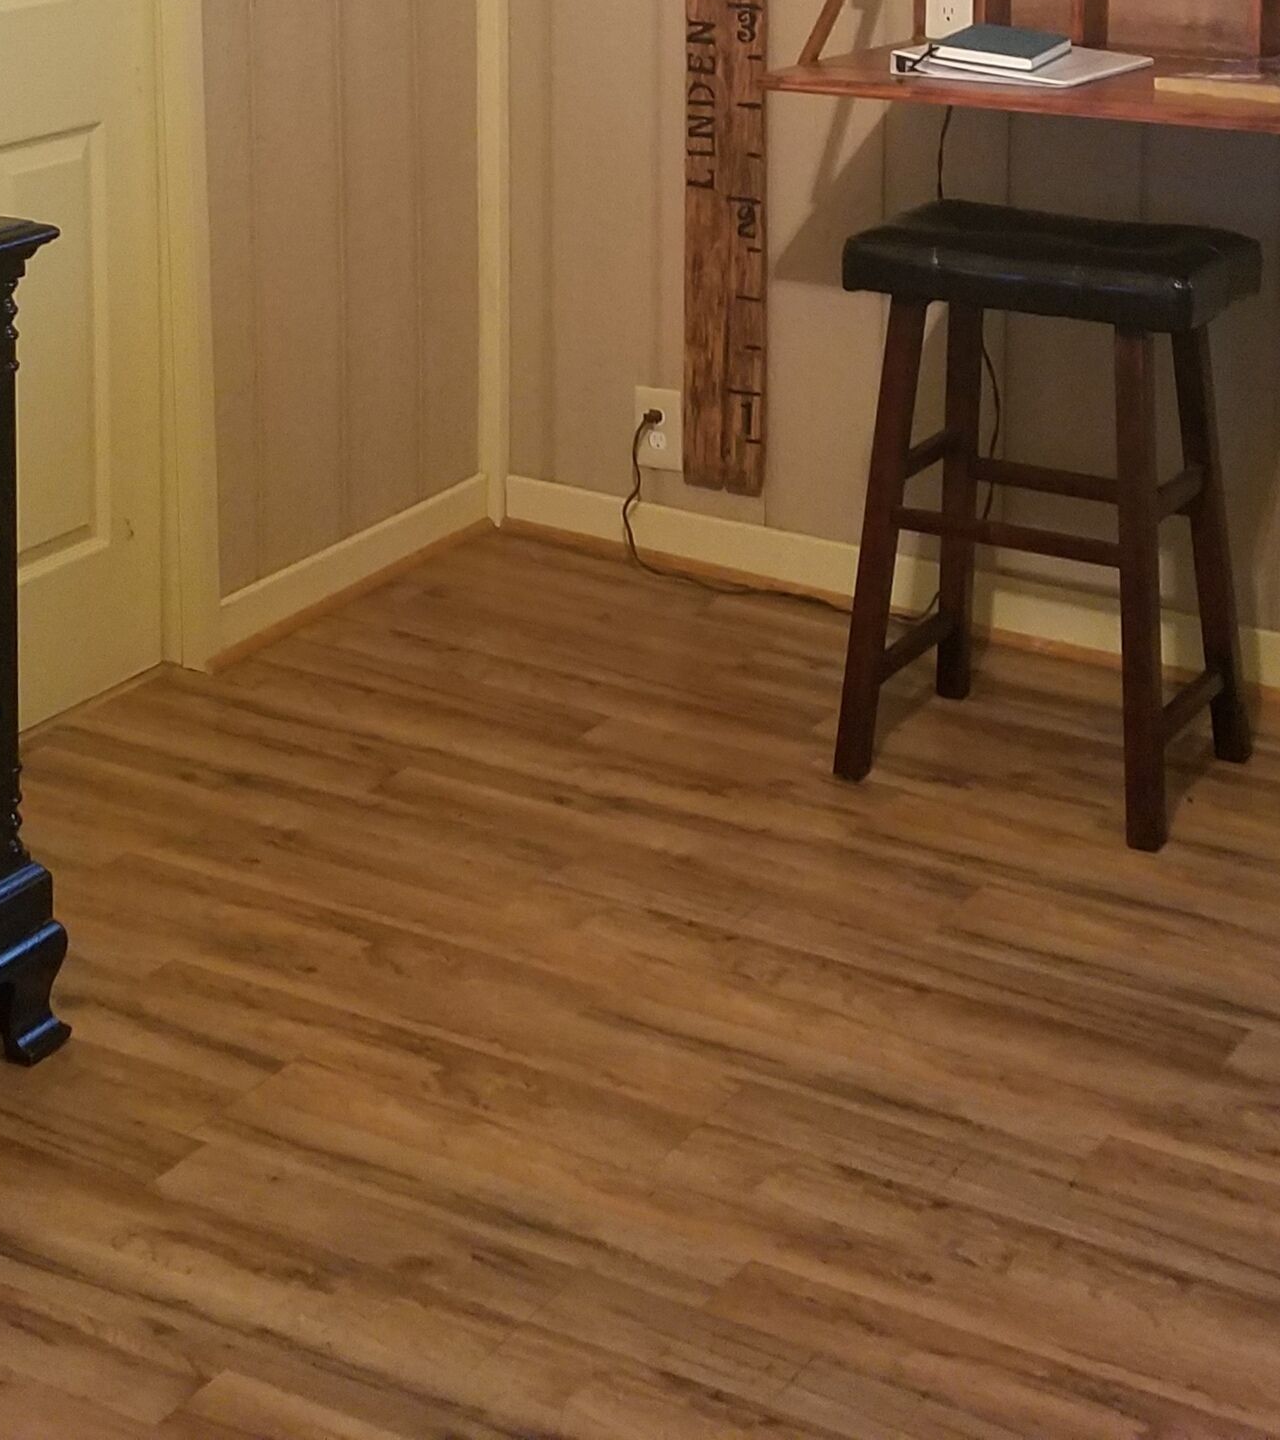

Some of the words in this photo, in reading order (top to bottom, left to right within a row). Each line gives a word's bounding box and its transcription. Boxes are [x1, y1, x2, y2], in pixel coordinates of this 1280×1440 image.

[737, 9, 758, 43] 3
[687, 20, 718, 191] LINDEN
[737, 204, 758, 239] 2
